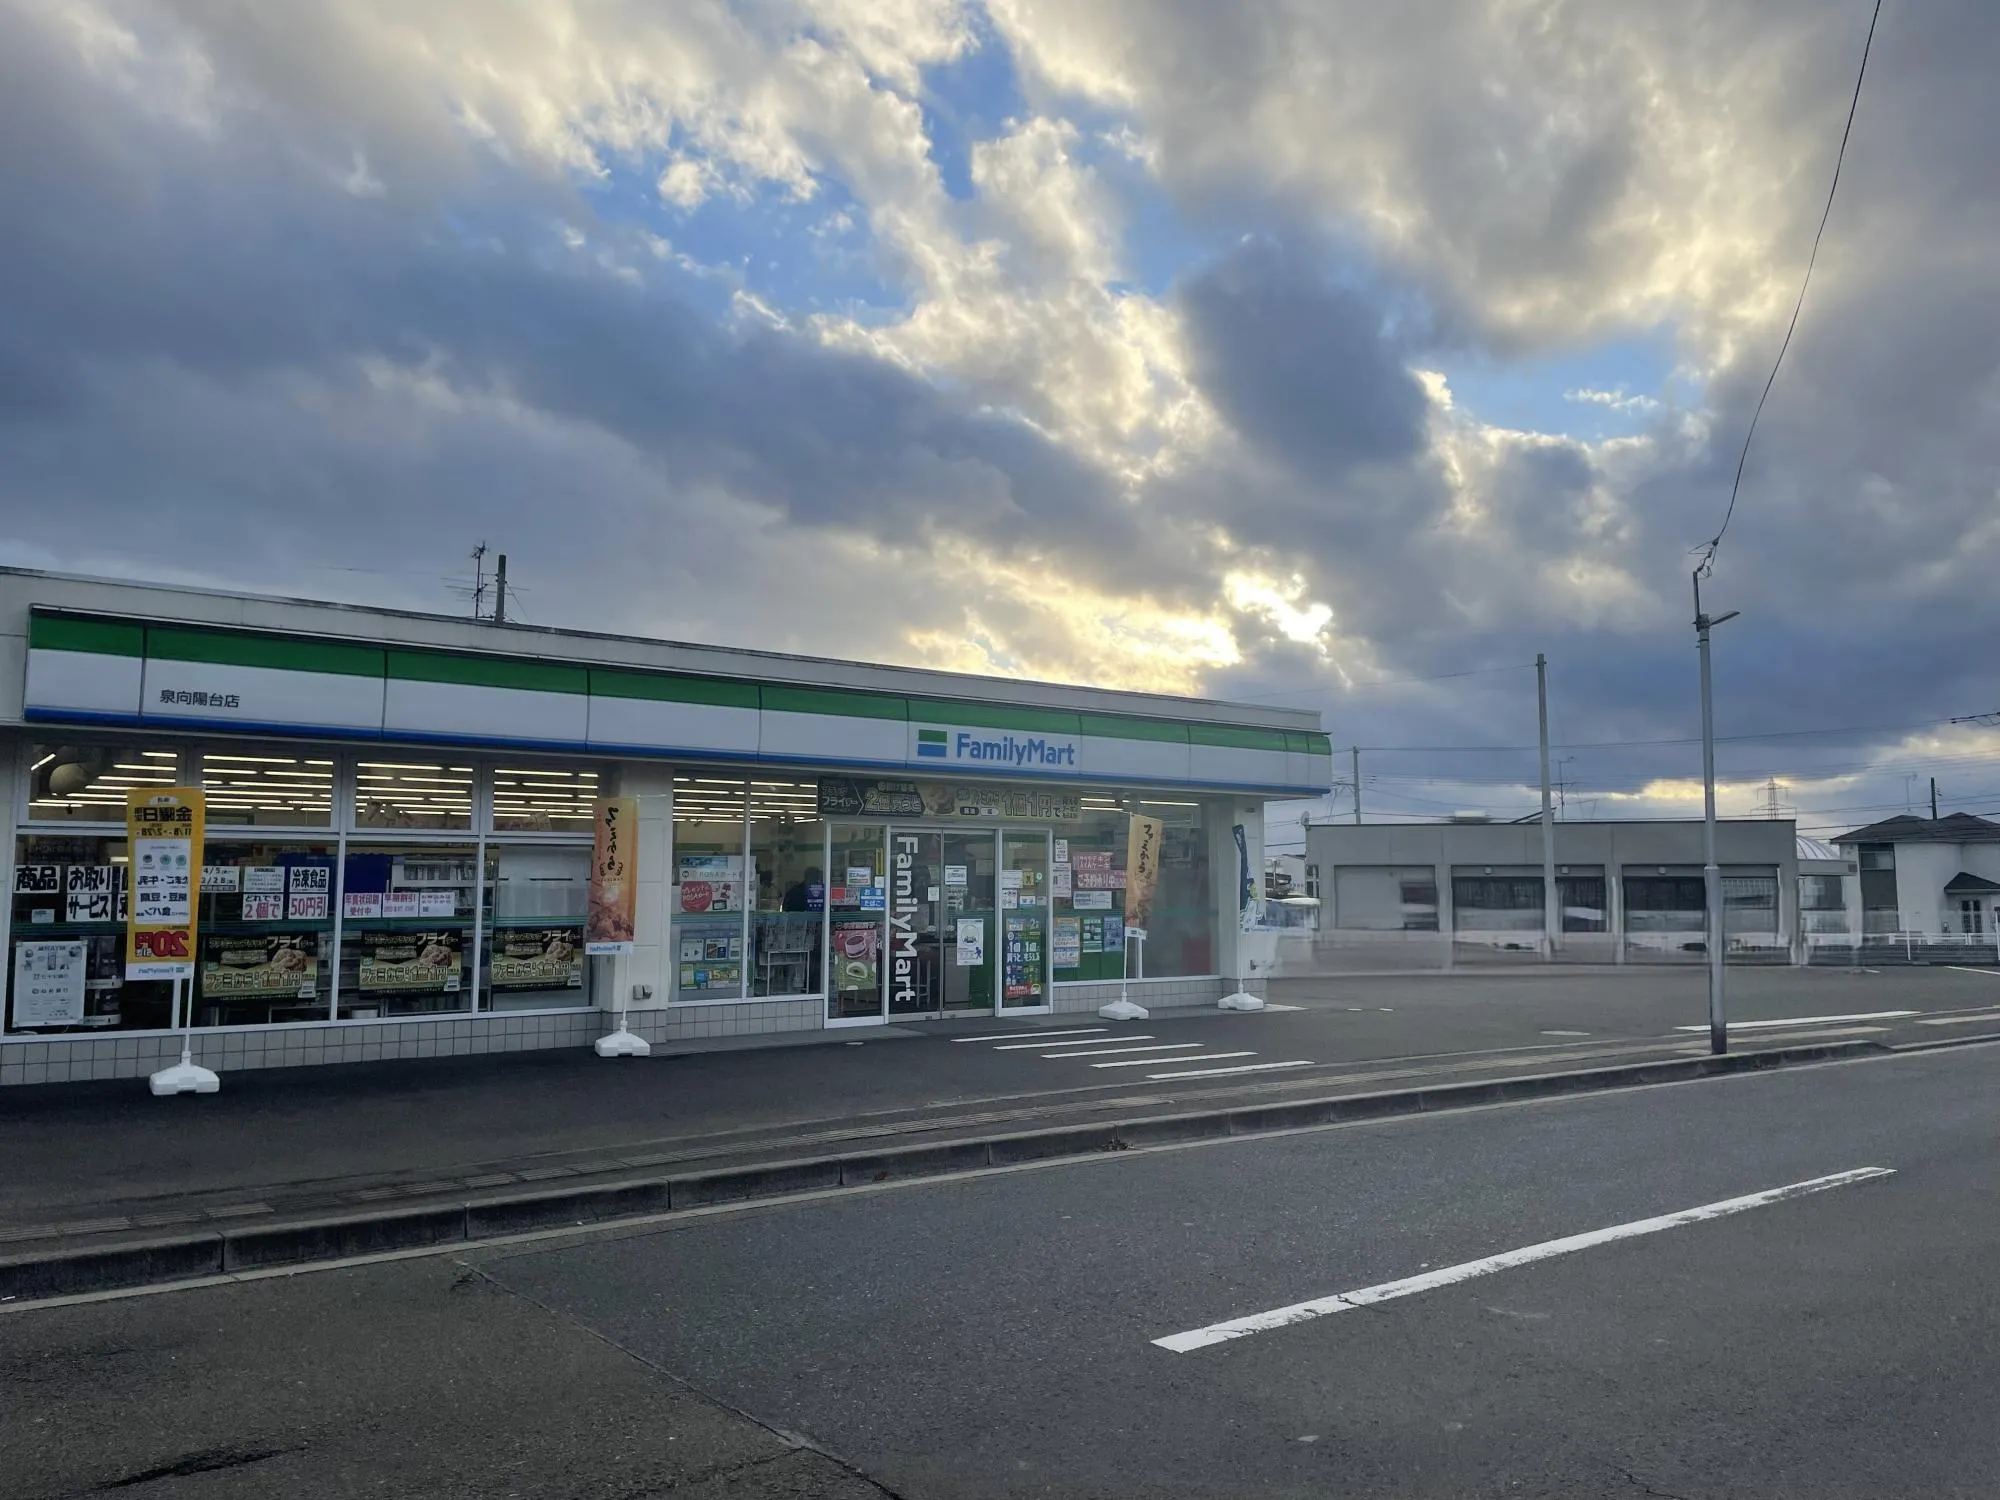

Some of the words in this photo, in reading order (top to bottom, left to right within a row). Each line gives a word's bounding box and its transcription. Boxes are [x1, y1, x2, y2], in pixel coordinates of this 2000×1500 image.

[160, 689, 240, 708] 泉向陽台店
[957, 733, 1075, 766] FamilyMart
[16, 866, 58, 891] 商品
[69, 866, 111, 891] お取り
[291, 869, 327, 889] 冷凍食品
[69, 895, 109, 919] サービス
[290, 896, 326, 917] 50円引
[890, 836, 919, 1002] FamilyMart
